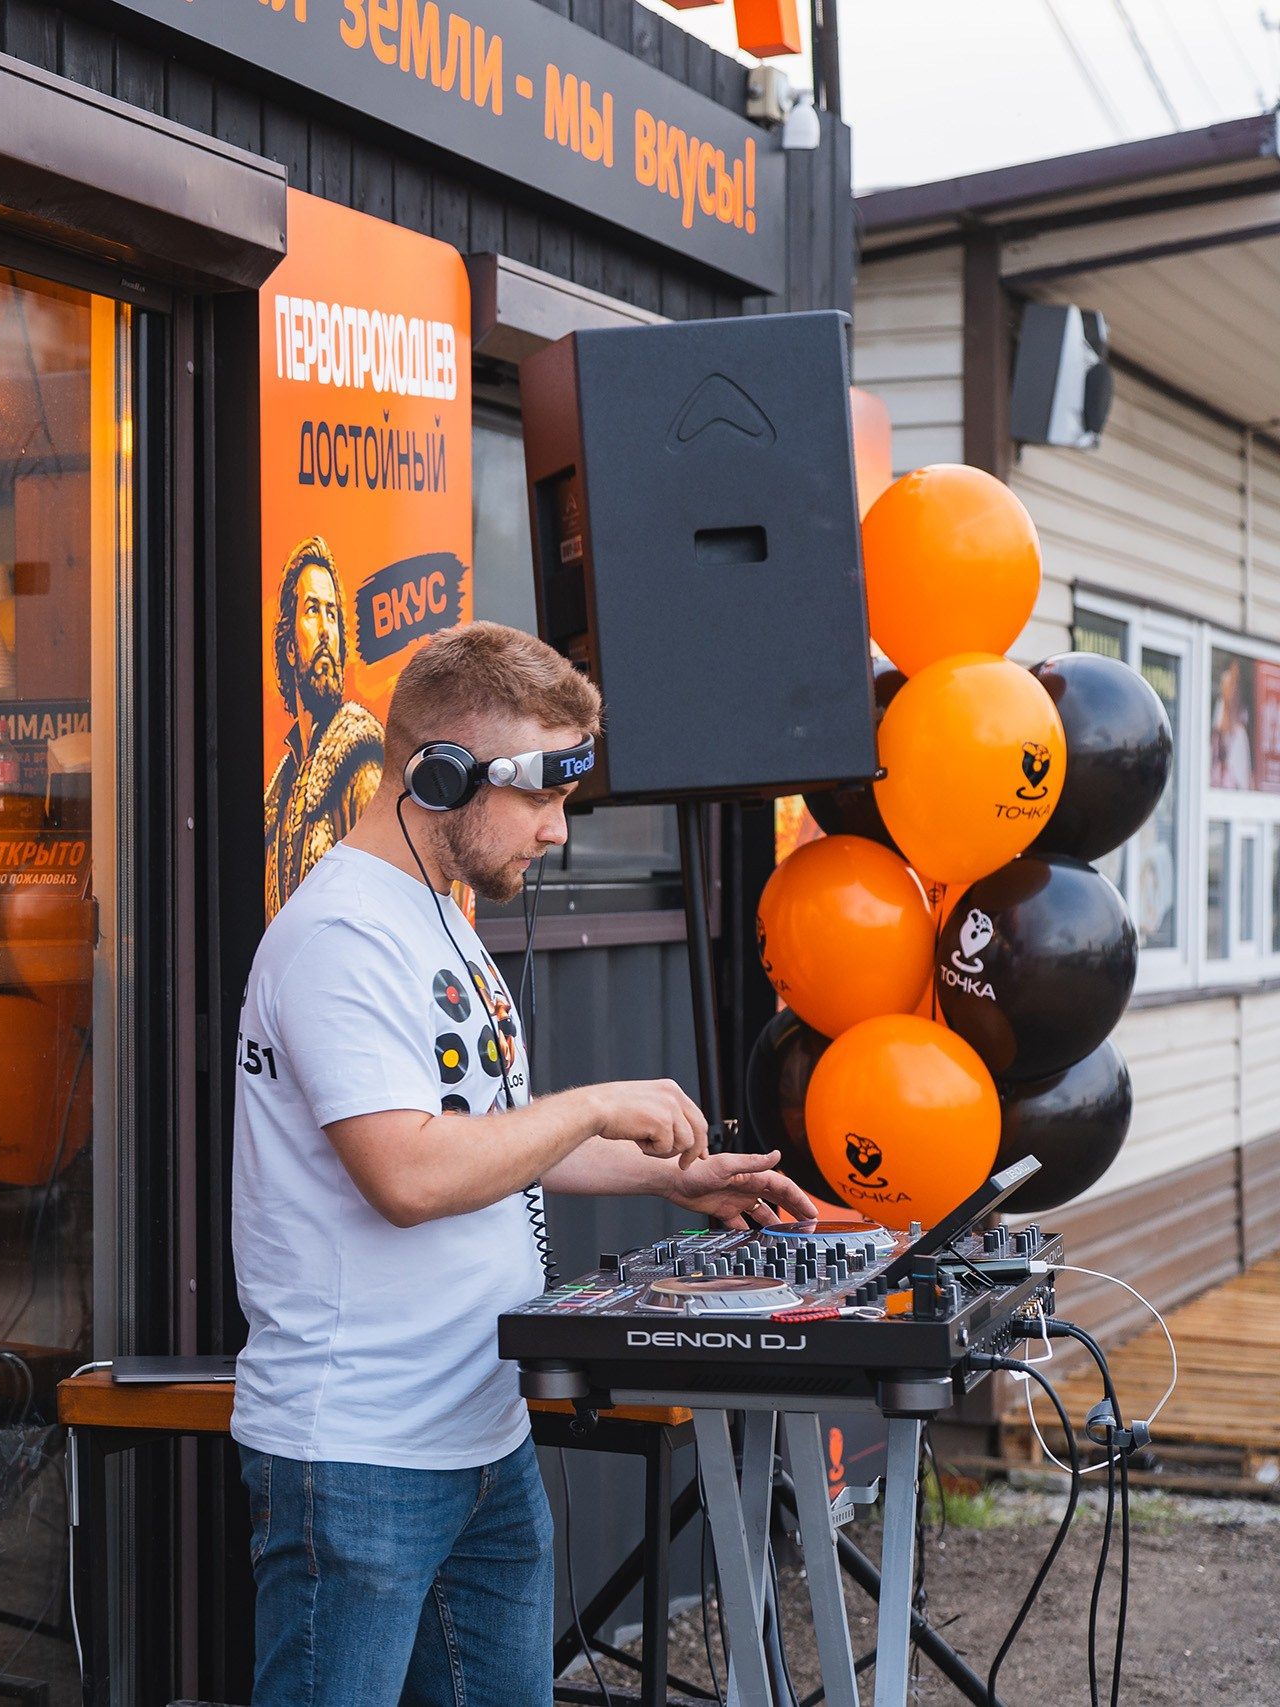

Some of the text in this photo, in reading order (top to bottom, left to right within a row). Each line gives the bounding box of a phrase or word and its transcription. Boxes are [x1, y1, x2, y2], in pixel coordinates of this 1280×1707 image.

[340, 0, 503, 116] земли
[544, 63, 614, 168] мы
[634, 108, 756, 234] вкусы!
[275, 294, 457, 401] ПЕРВОПРОХОДЦЕВ
[298, 409, 446, 493] ДОСТОЙНЫЙ
[372, 571, 448, 639] ВКУС
[560, 750, 595, 778] Tech
[995, 803, 1050, 820] ТОЧКА
[9, 873, 78, 885] ПОЖАЛОВАТЬ
[940, 964, 996, 1001] ТОЧКА
[238, 1031, 278, 1080] 51
[837, 1181, 912, 1203] ТОЧКА
[627, 1331, 807, 1350] DENON DJ
